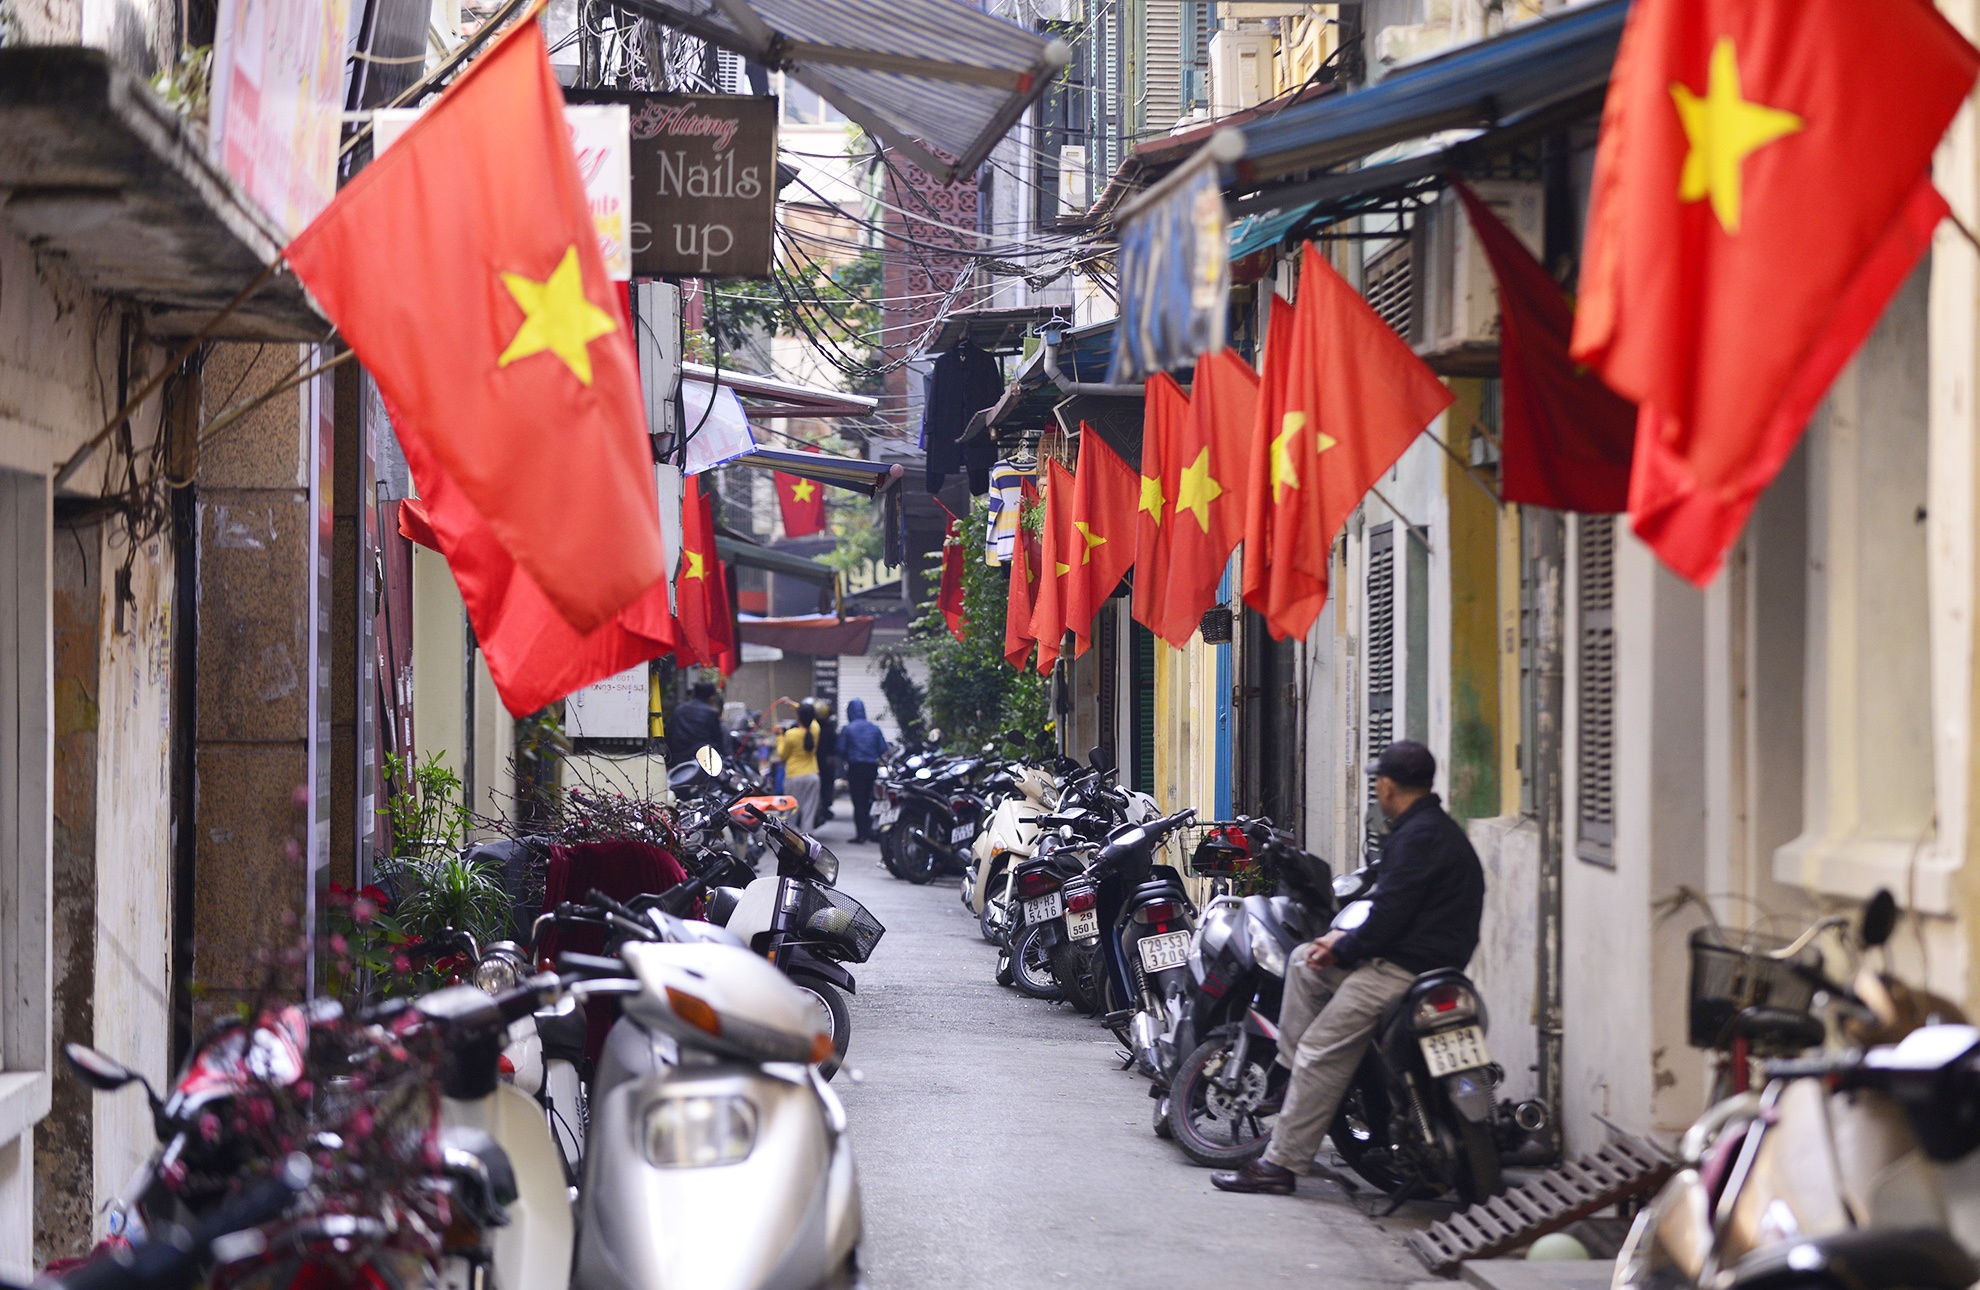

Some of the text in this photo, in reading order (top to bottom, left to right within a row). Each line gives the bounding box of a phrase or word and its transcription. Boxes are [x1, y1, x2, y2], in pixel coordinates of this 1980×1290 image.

[657, 148, 761, 199] Nails
[673, 222, 733, 273] up
[1028, 894, 1055, 912] 29-H3
[1029, 905, 1057, 923] 5416
[1080, 912, 1093, 922] 29
[1072, 923, 1089, 935] 550
[1147, 934, 1183, 953] 29-S3
[1150, 948, 1187, 967] 3209
